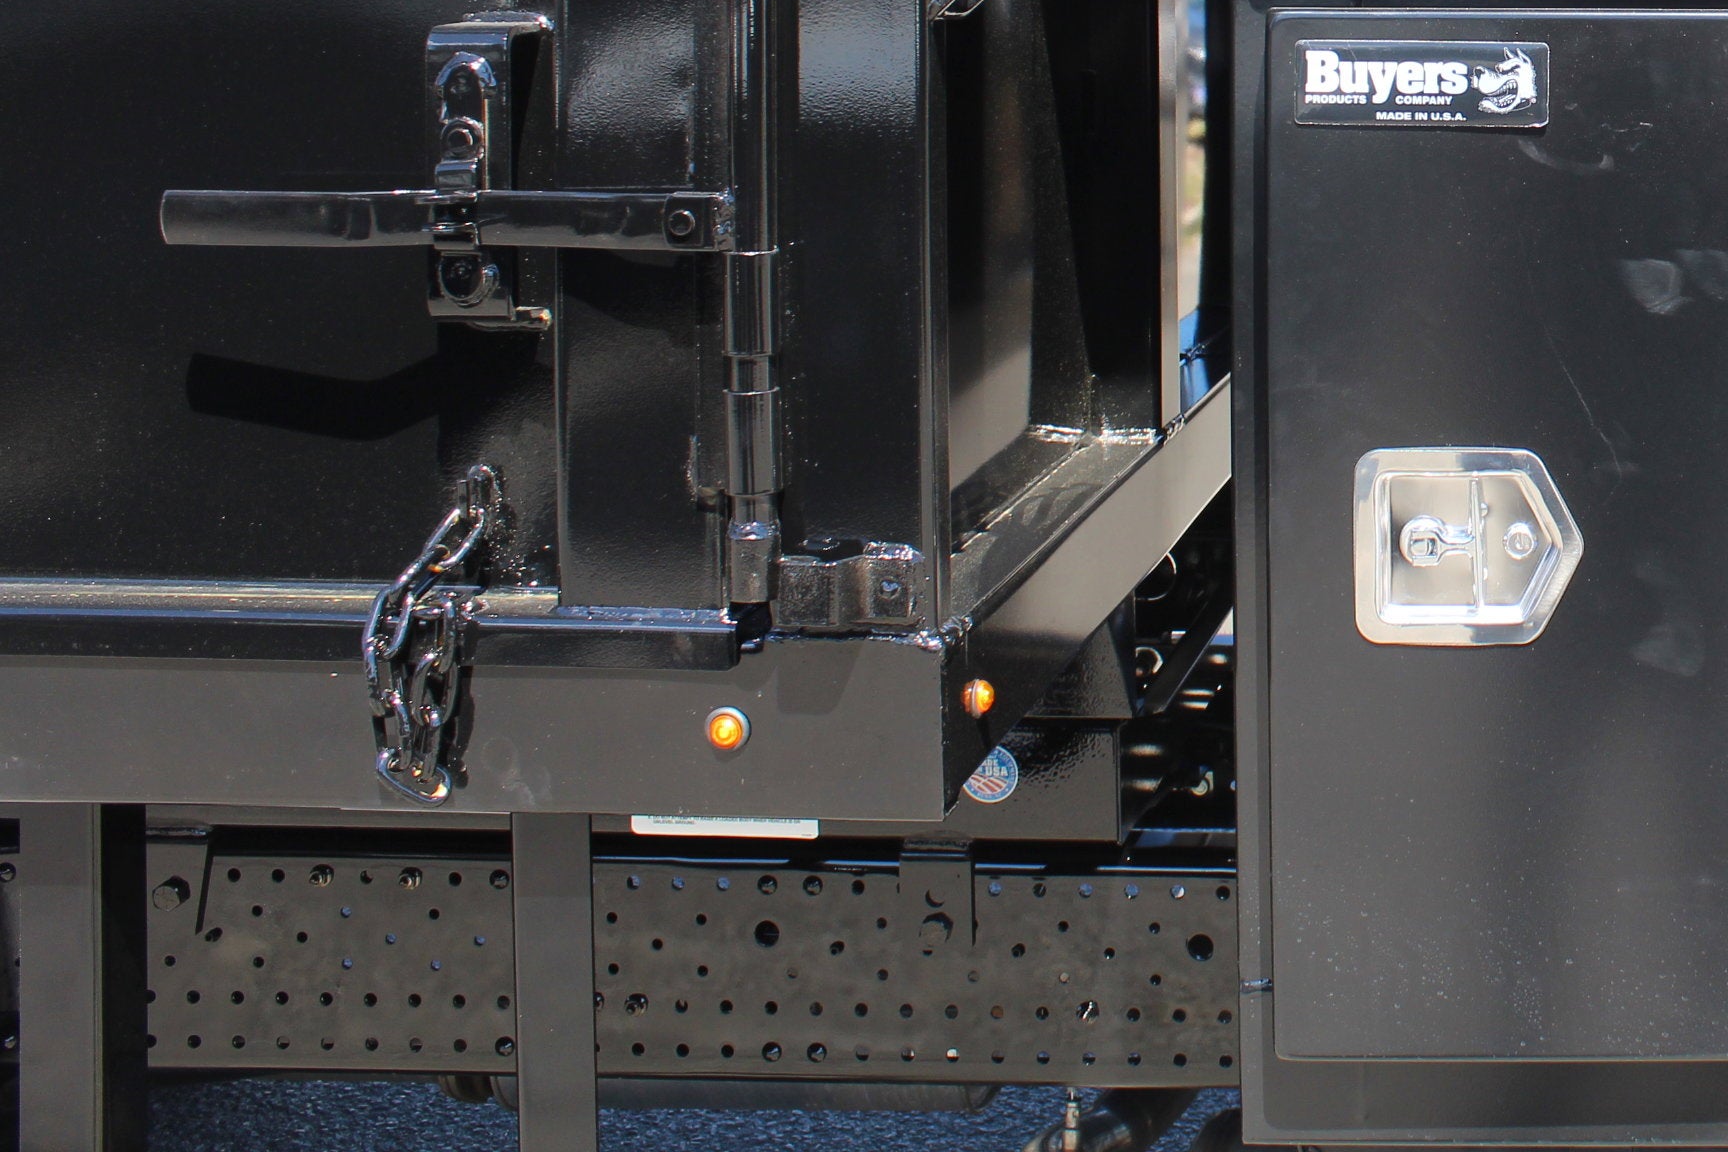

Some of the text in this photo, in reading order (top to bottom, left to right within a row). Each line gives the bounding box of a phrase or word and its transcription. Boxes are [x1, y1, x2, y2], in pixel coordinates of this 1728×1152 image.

[1305, 50, 1468, 104] Buyers
[1304, 94, 1453, 105] PRODUCTS COMPANY
[1375, 111, 1467, 121] MADE IN U.S.A.
[985, 766, 1008, 776] USA
